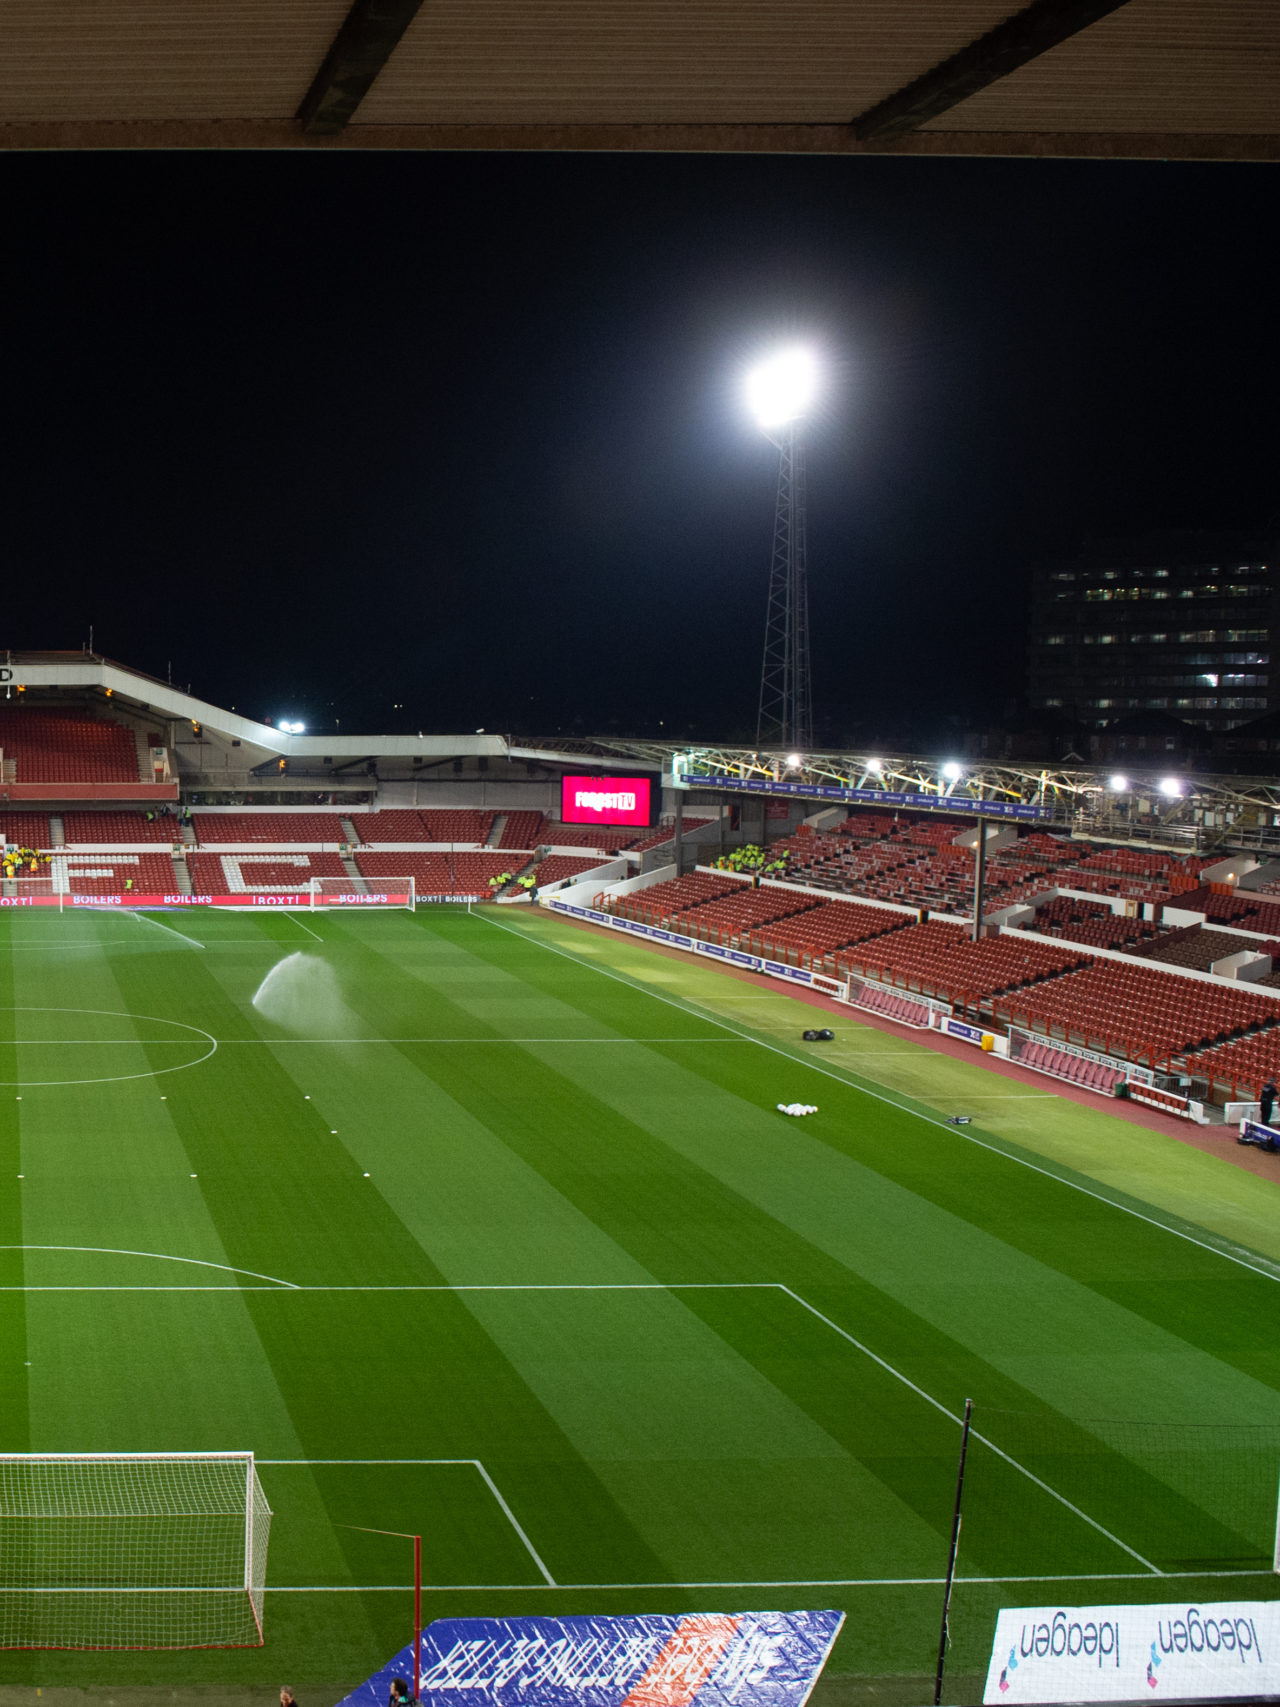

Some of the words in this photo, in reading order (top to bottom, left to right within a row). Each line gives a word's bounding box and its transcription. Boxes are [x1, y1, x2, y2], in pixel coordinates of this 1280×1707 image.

[73, 895, 122, 904] BOILERS
[163, 895, 212, 904] BOILERS
[1020, 1611, 1120, 1668] Ideagen
[1158, 1608, 1263, 1664] Ideagen
